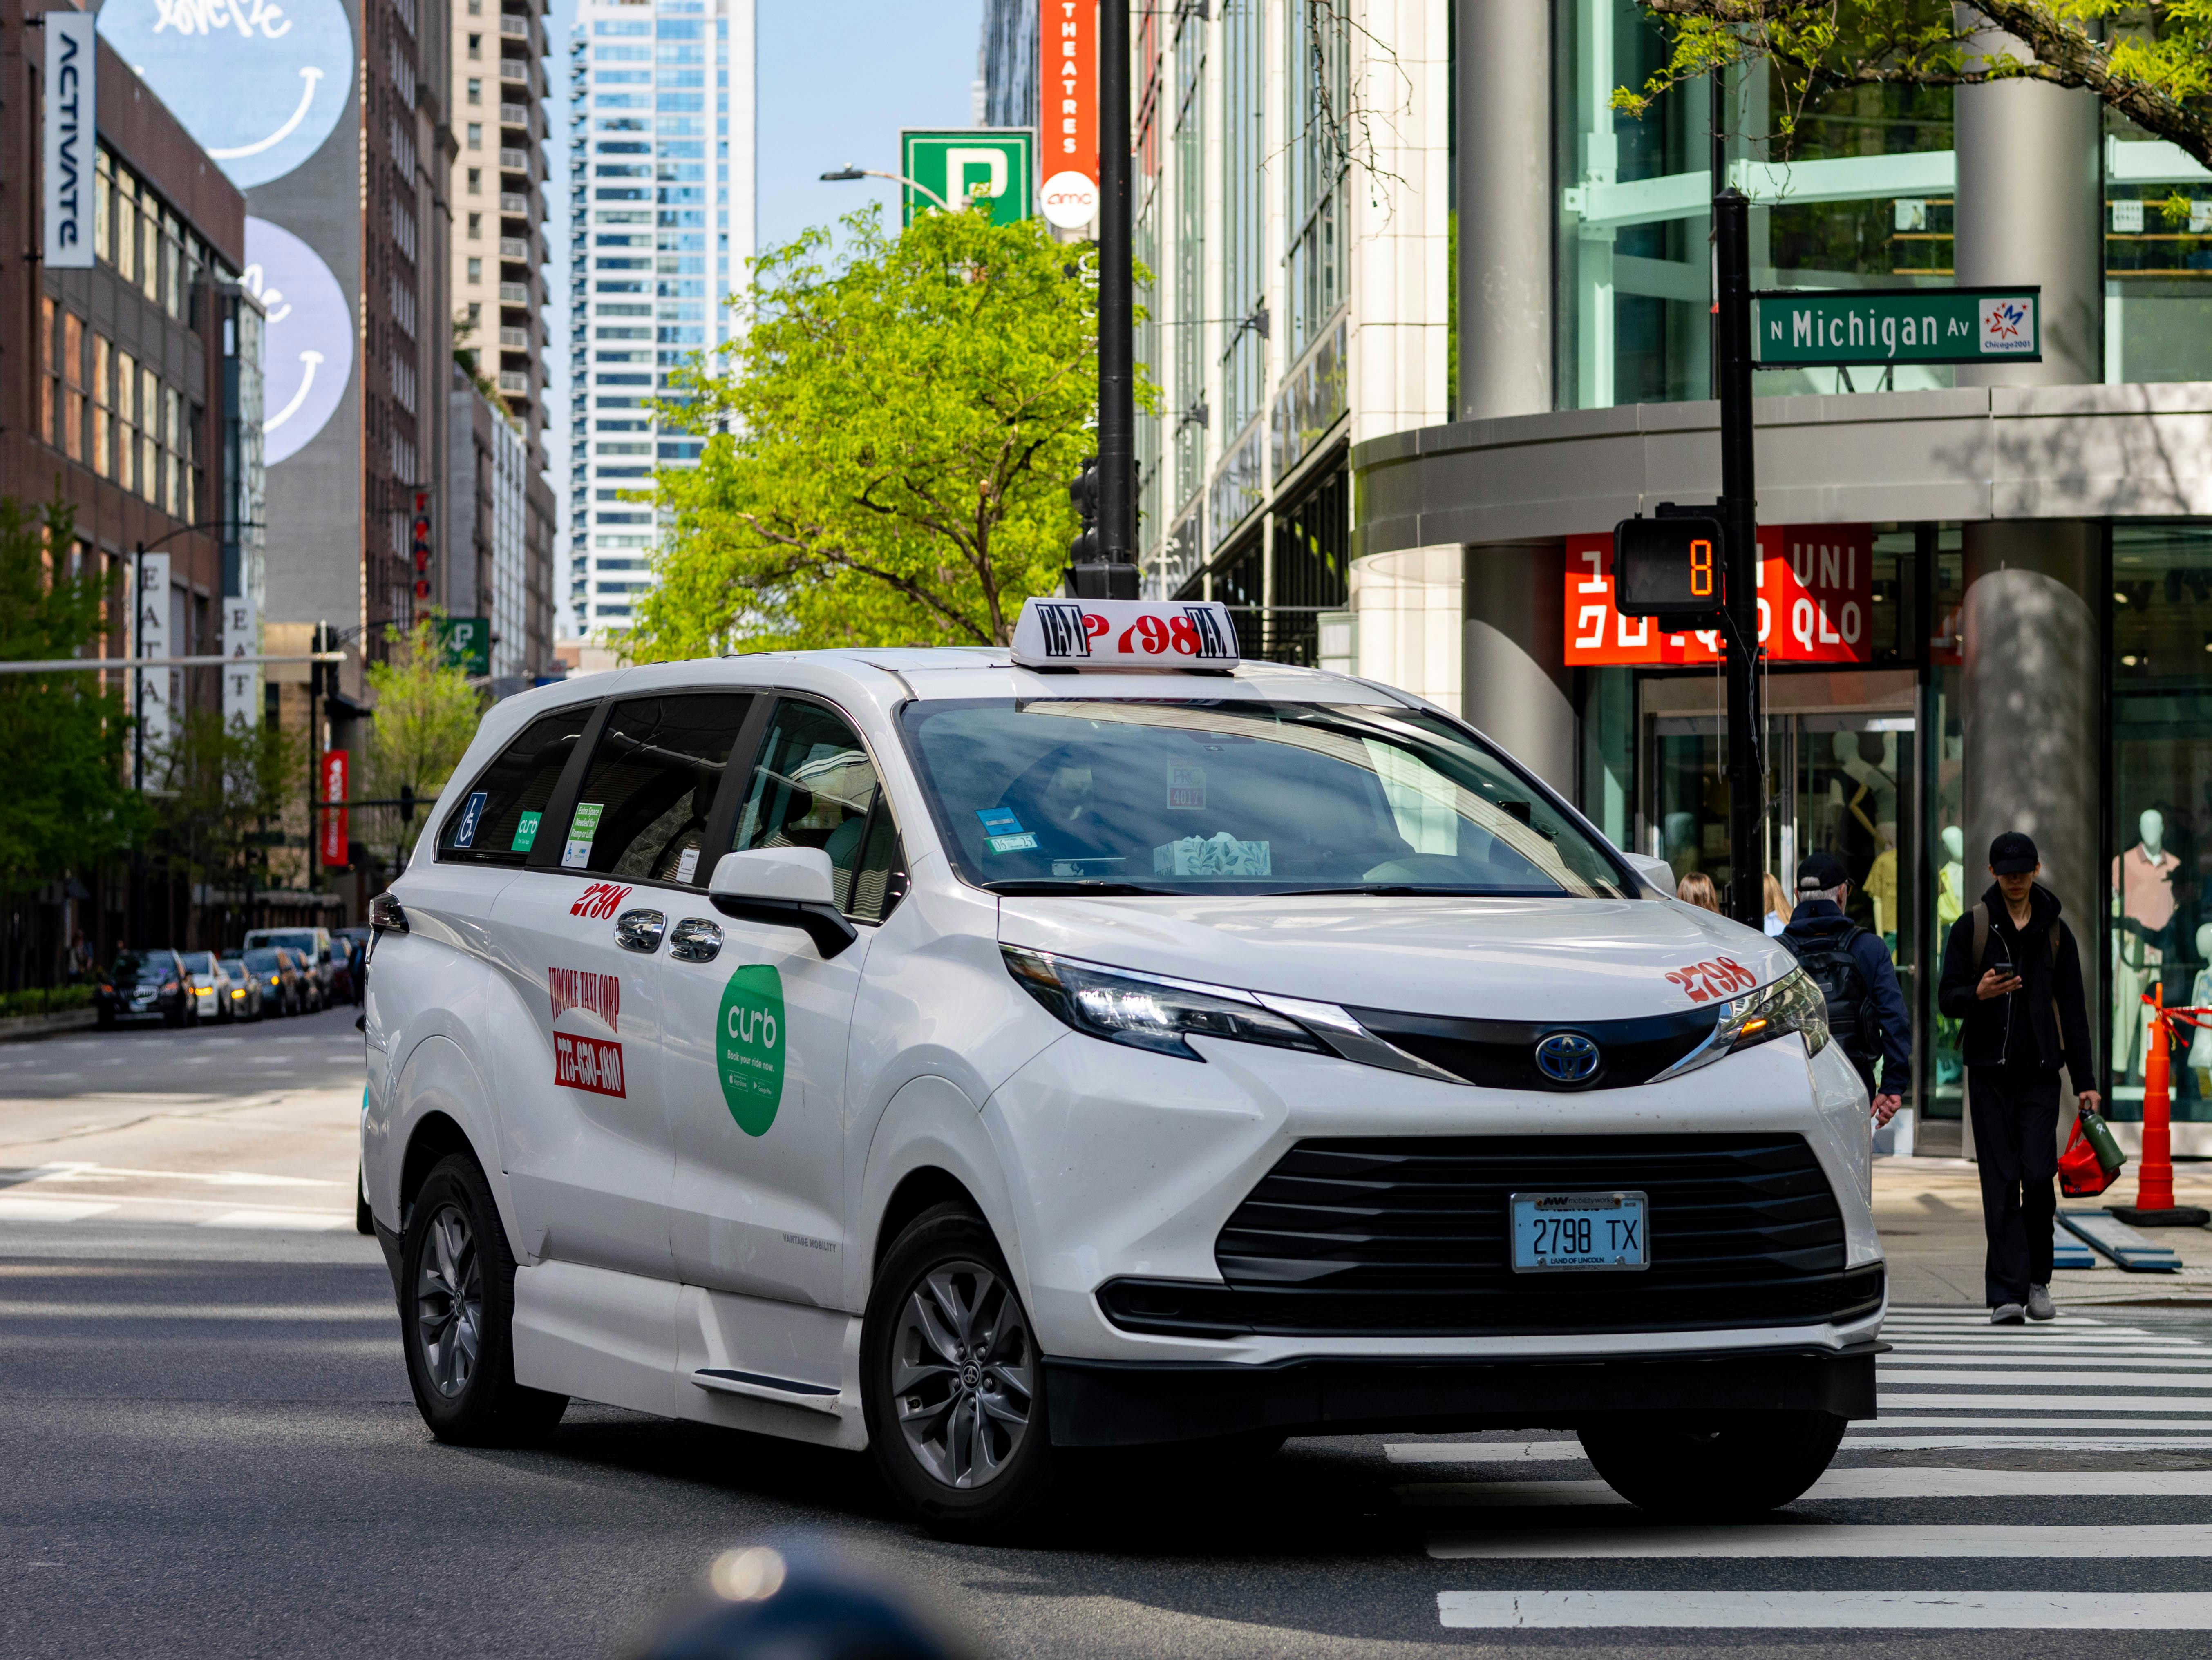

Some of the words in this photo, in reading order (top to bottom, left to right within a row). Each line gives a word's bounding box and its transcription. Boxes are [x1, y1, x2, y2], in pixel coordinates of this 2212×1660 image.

[1061, 2, 1077, 153] THEATRES
[1047, 193, 1092, 204] amc
[1771, 321, 1783, 340] N
[1792, 309, 1937, 358] Michigan
[1947, 317, 1969, 337] Av
[1793, 543, 1855, 590] UNI
[1792, 598, 1861, 652] QLO
[578, 806, 588, 815] Extra
[588, 807, 599, 817] Space
[1173, 789, 1199, 804] 4017
[519, 818, 538, 834] curb
[575, 818, 590, 827] Needed
[570, 883, 632, 920] 2798
[1664, 956, 1757, 1003] 2798
[580, 971, 597, 1014] TAXI
[599, 974, 620, 1034] CORP
[728, 1005, 776, 1048] curb
[727, 1049, 739, 1061] Book
[740, 1055, 751, 1065] your
[751, 1057, 762, 1068] ride
[783, 1233, 809, 1247] VANTAGE
[810, 1238, 836, 1253] MOBILITY
[1533, 1218, 1591, 1254] 2798
[1606, 1219, 1638, 1250] TX
